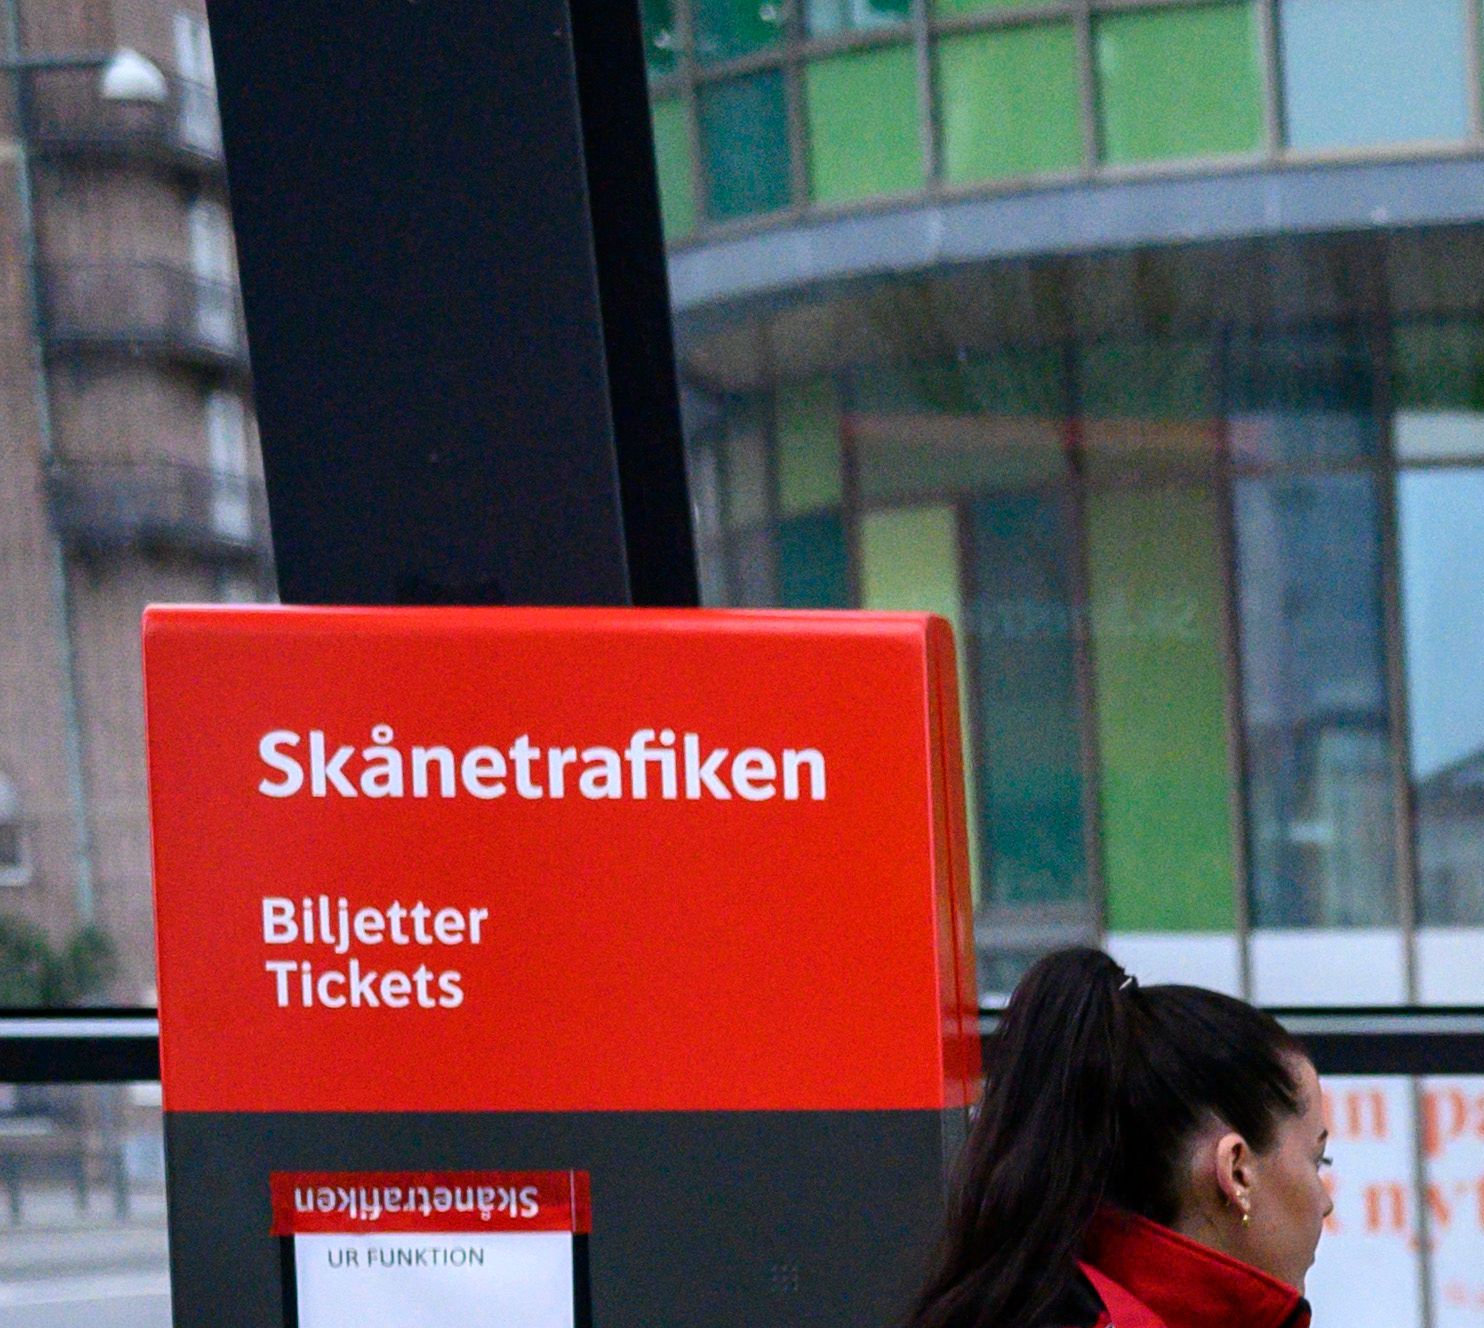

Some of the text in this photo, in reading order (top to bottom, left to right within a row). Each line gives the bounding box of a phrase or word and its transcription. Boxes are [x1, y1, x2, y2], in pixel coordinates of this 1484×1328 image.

[258, 724, 827, 802] Skånetrafiken
[261, 895, 490, 954] Biljetter
[265, 956, 465, 1009] Tickets
[294, 1186, 540, 1222] Skånetrafiken
[327, 1247, 485, 1268] UR FUNKTION
